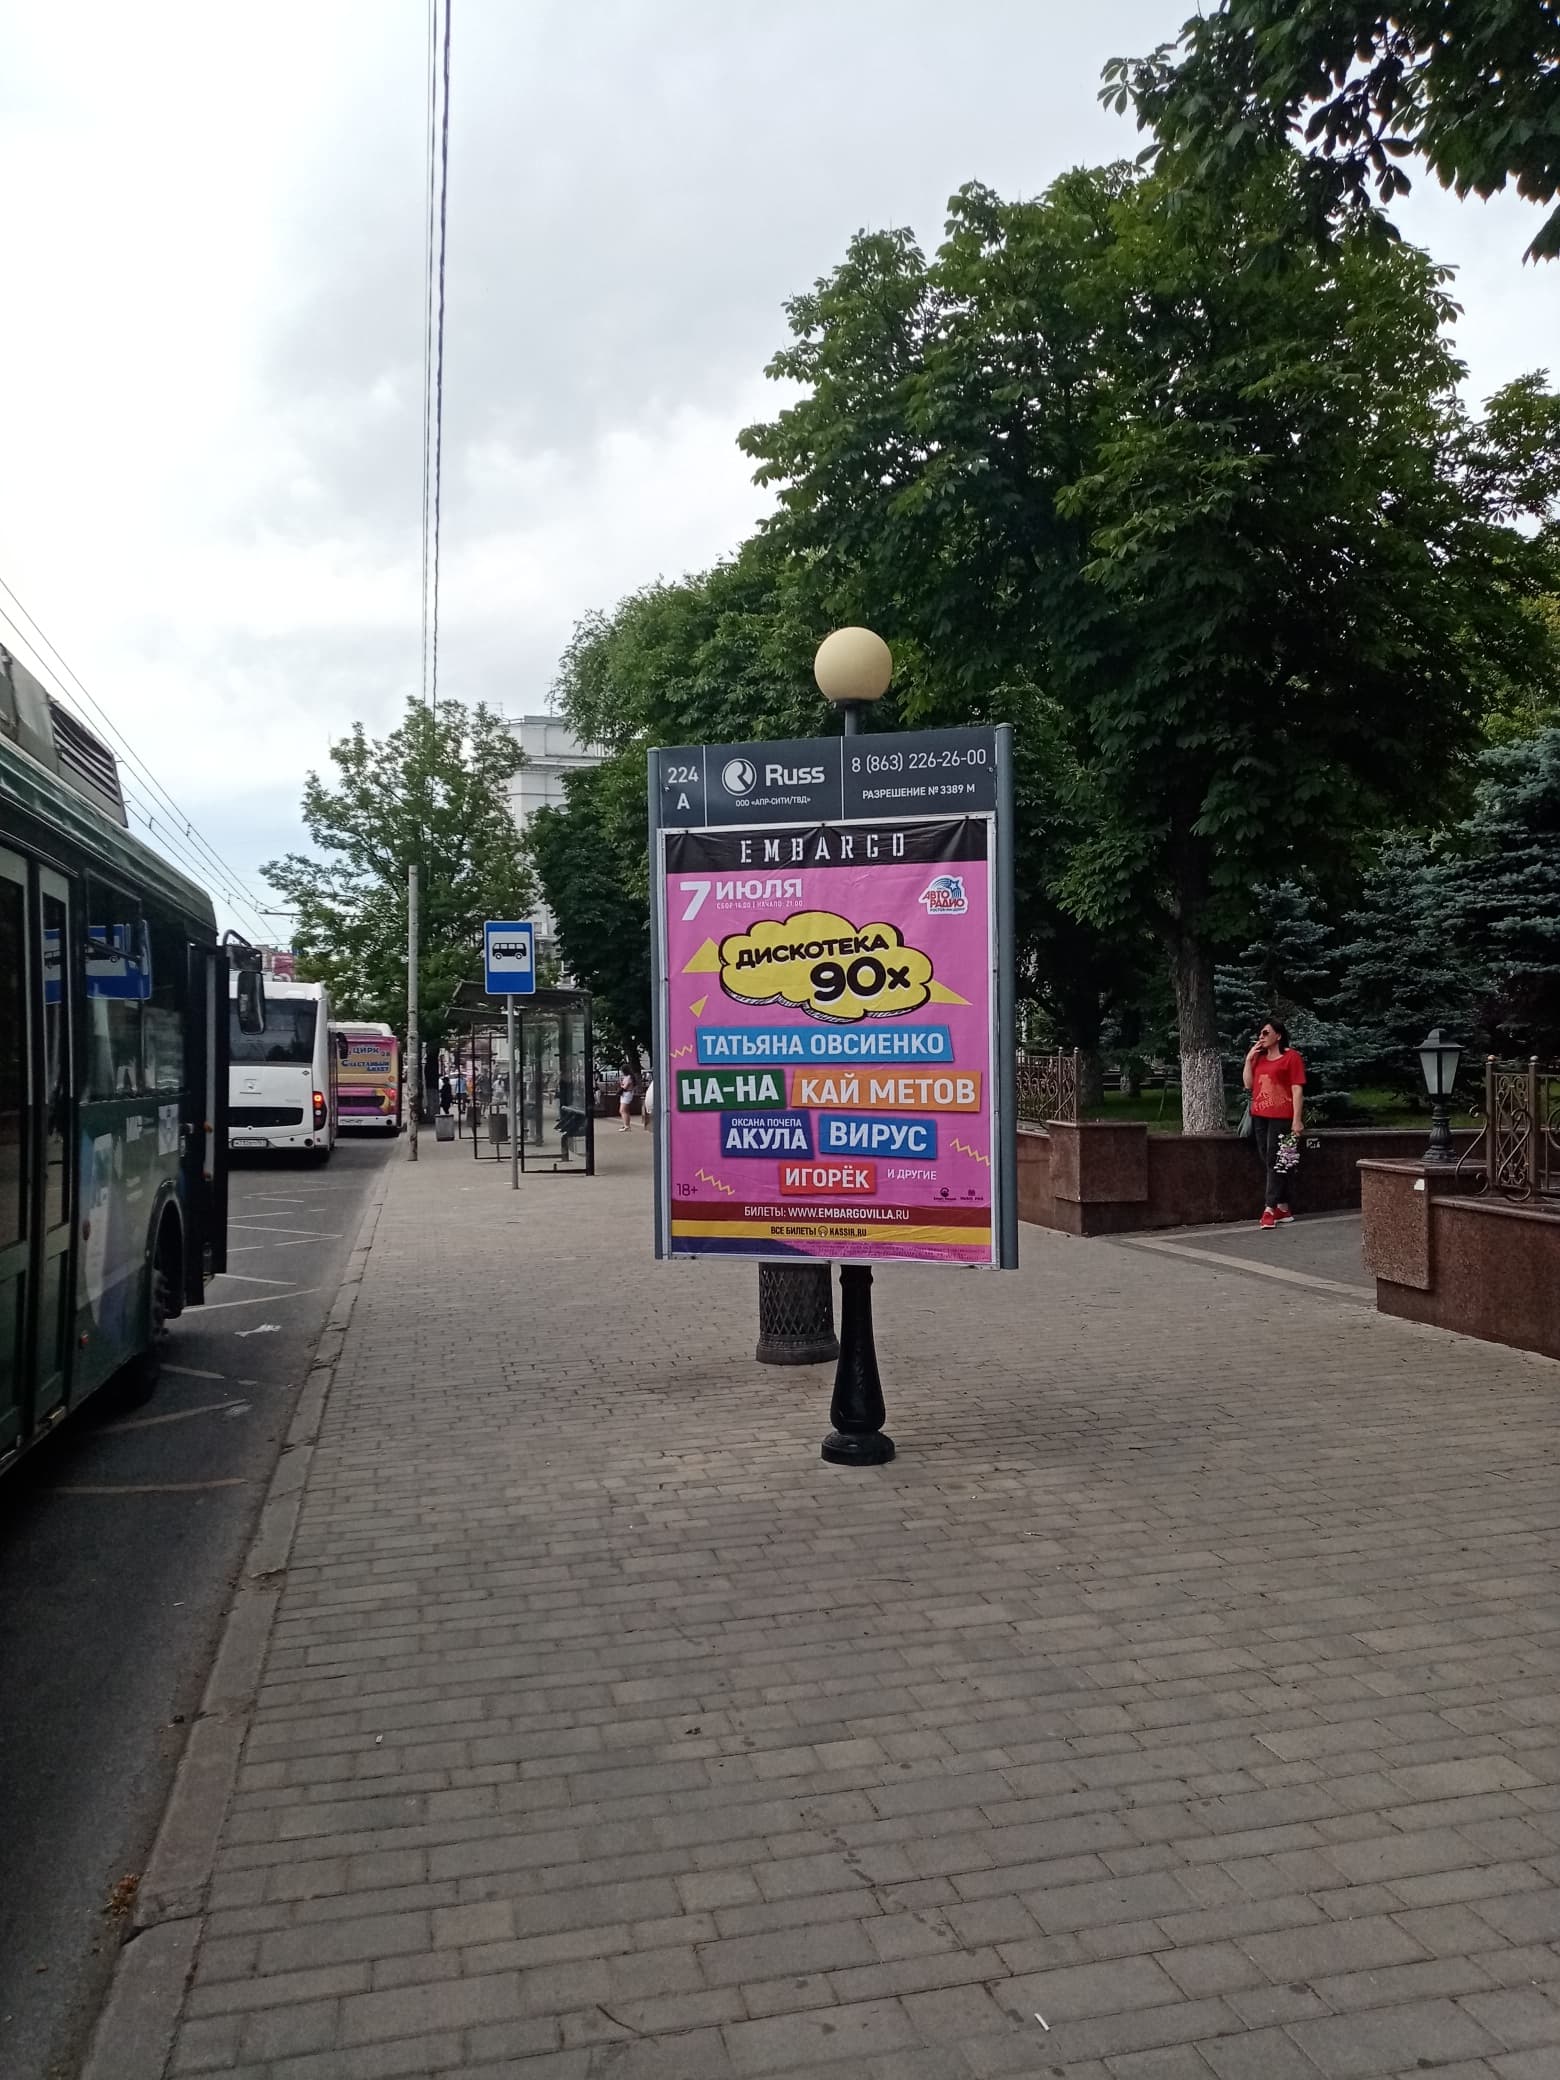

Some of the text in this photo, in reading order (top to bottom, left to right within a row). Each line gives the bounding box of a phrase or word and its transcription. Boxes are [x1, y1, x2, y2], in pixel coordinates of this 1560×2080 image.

[851, 749, 987, 774] 8 (863) 226-26-00
[667, 765, 699, 784] 224
[765, 764, 825, 786] Russ
[676, 793, 691, 810] А
[862, 786, 926, 799] РАЗРЕШЕНИЕ
[940, 784, 964, 795] 3389
[966, 783, 976, 793] М
[740, 832, 905, 864] EMBARGO
[679, 878, 802, 921] 7 ИЮЛЯ
[922, 889, 950, 900] АВТО
[930, 898, 965, 908] РАДИО
[735, 933, 890, 970] ДИСКОТЕКА
[810, 956, 911, 1002] 90х
[702, 1032, 944, 1056] ТАТЬЯНА ОВСИЕНКО
[681, 1074, 780, 1105] НА-НА
[801, 1073, 976, 1105] КАЙ МЕТОВ
[731, 1118, 802, 1128] ОКСАНА ПОЧЕПА
[725, 1127, 808, 1150] АКУЛА
[829, 1121, 928, 1152] ВИРУС
[785, 1165, 871, 1188] ИГОРЁК
[887, 1169, 937, 1181] И ДРУГИЕ
[676, 1183, 698, 1197] 18+
[744, 1206, 910, 1220] БИЛЕТЫ: WWW.EMBARGOVILLA.RU
[770, 1226, 867, 1237] ВСЕ БИЛЕТЫ KASSIR.RU
